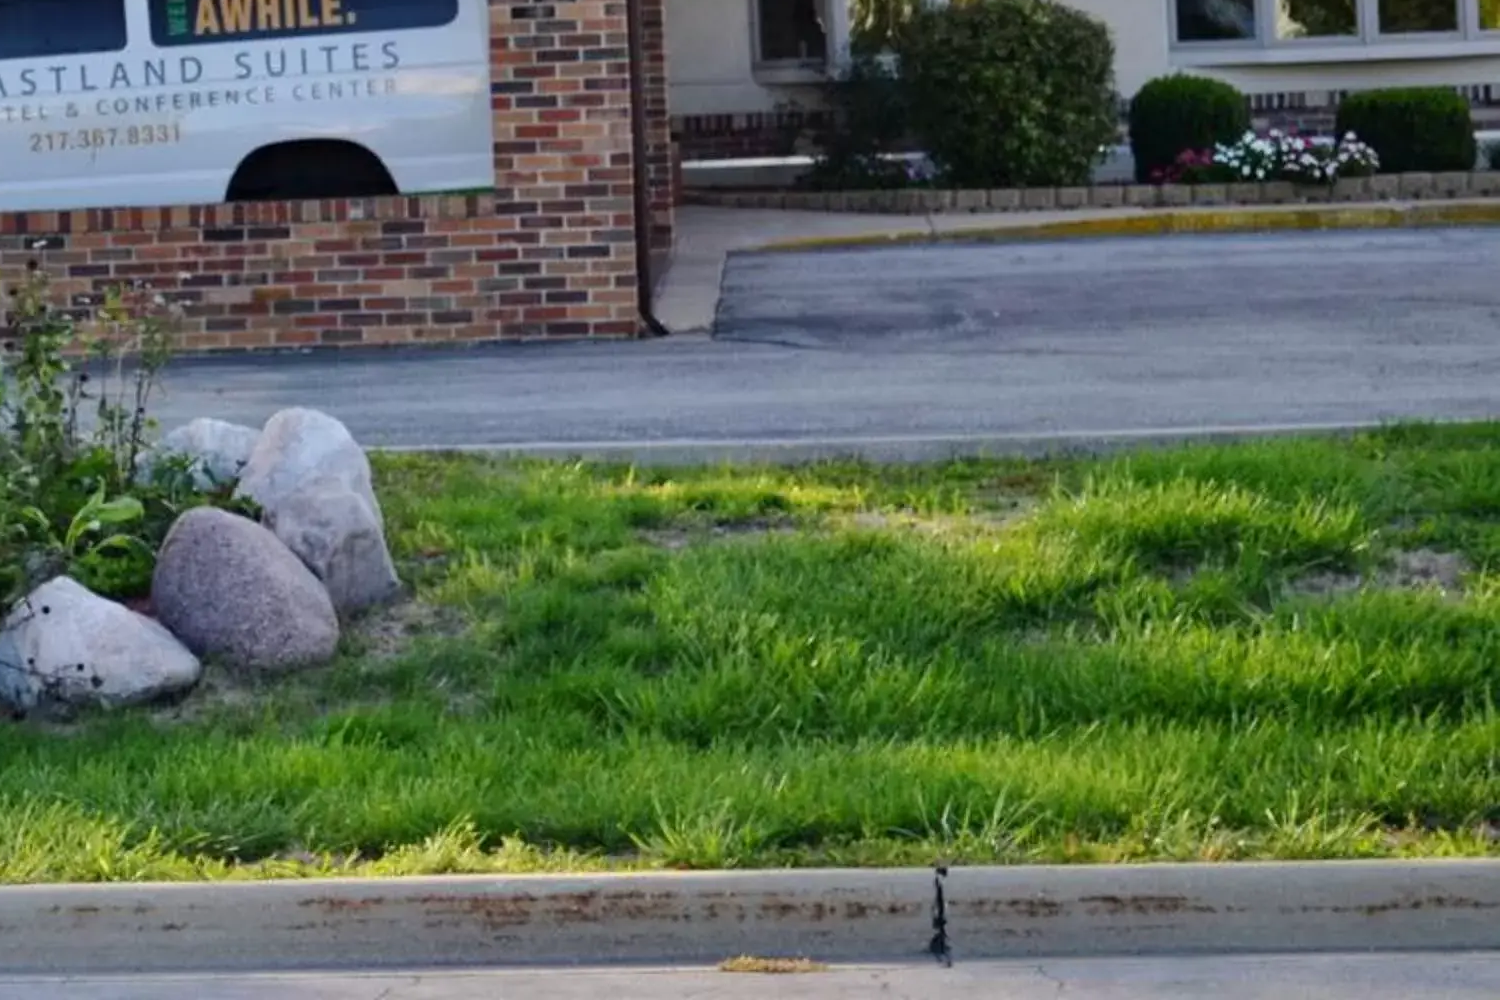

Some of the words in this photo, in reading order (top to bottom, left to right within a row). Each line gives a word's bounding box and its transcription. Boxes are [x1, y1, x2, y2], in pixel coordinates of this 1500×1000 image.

[234, 41, 400, 80] SUITES
[65, 102, 80, 118] &
[95, 86, 277, 117] CONFERENCE
[292, 77, 398, 102] CENTER
